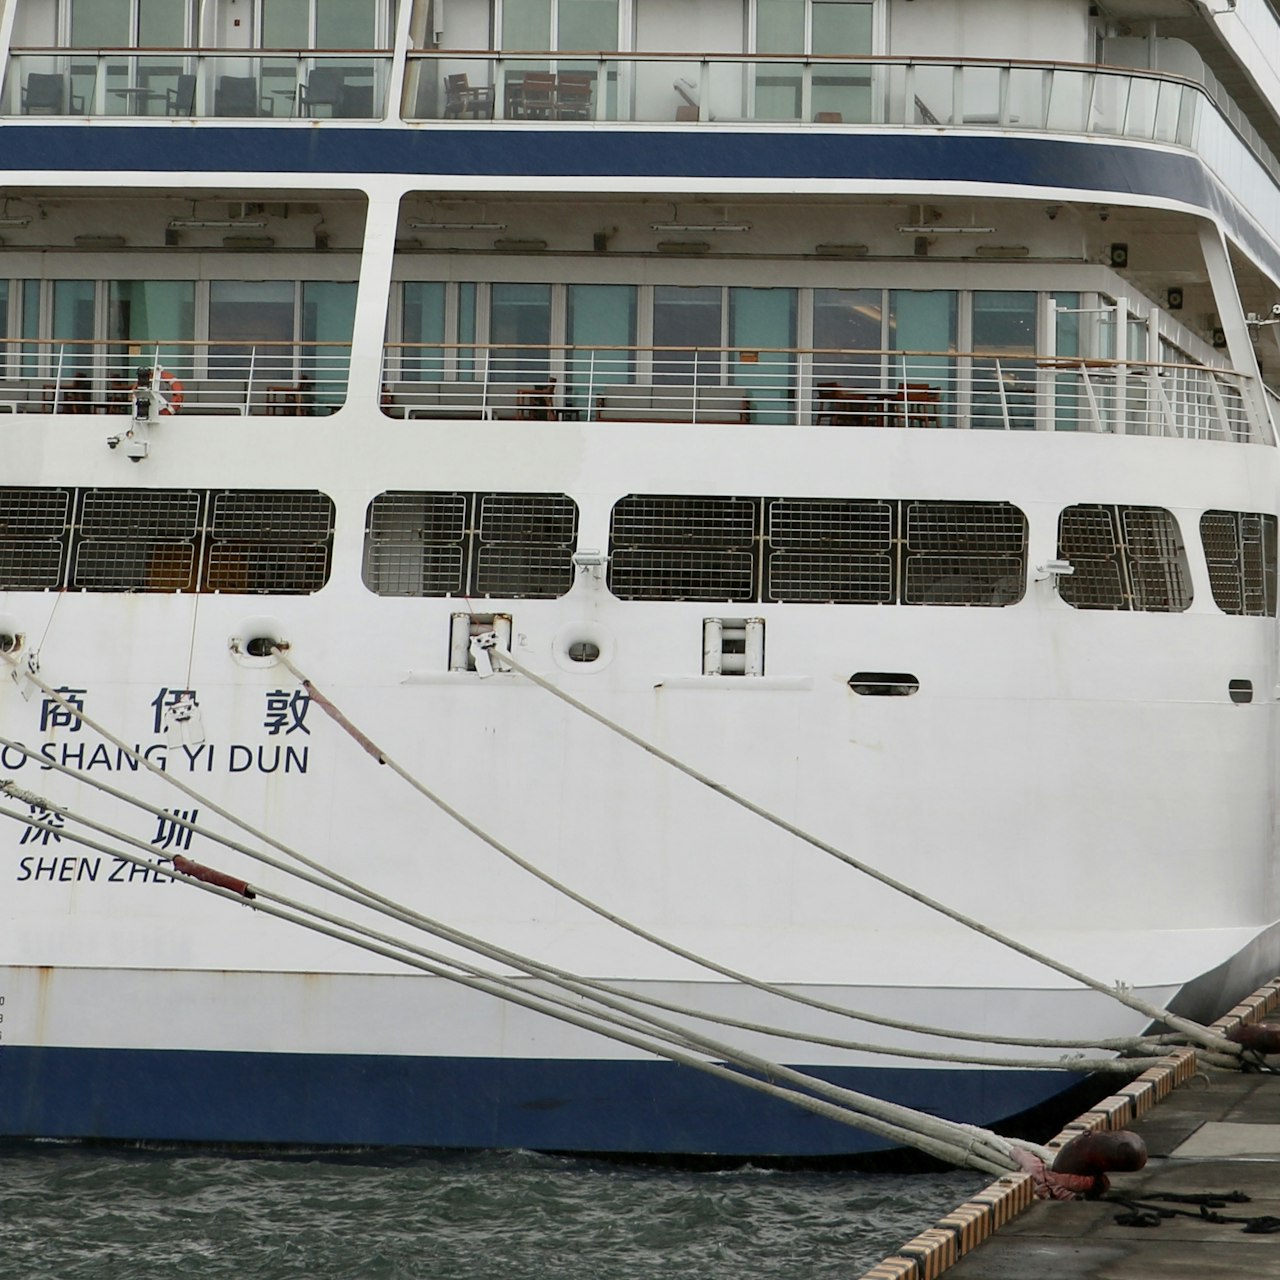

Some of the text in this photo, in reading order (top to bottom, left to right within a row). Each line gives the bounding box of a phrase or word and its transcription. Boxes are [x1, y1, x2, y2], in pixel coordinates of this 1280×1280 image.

[39, 742, 167, 772] SHANG
[183, 744, 215, 773] YI
[228, 744, 310, 774] DUN
[17, 856, 194, 883] SHEN ZHE
